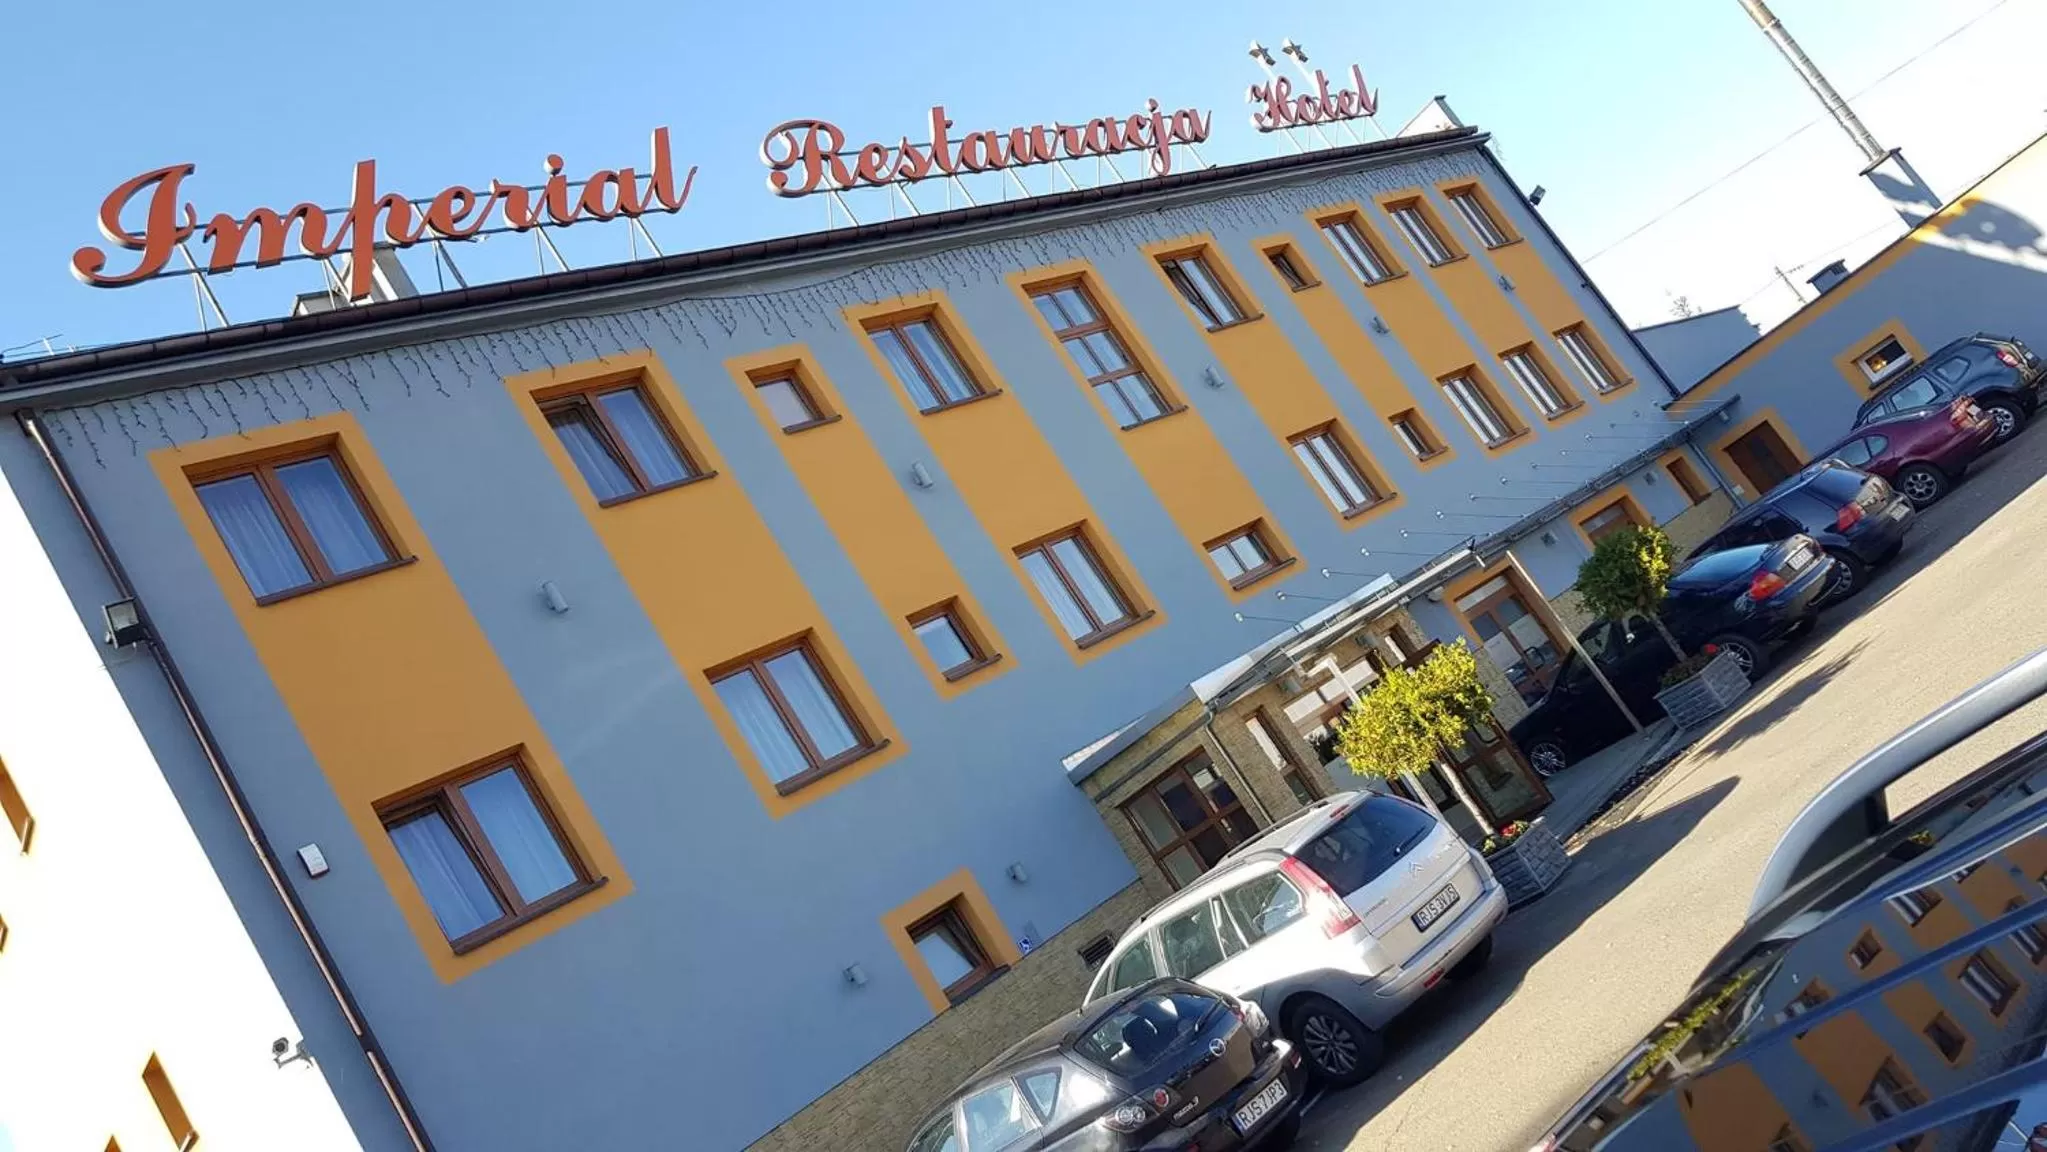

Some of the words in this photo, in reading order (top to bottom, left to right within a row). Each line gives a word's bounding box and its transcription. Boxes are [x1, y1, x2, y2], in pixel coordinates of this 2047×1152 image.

[71, 126, 698, 300] Imperial
[760, 98, 1212, 198] Restauracja
[1248, 63, 1379, 132] Hotel
